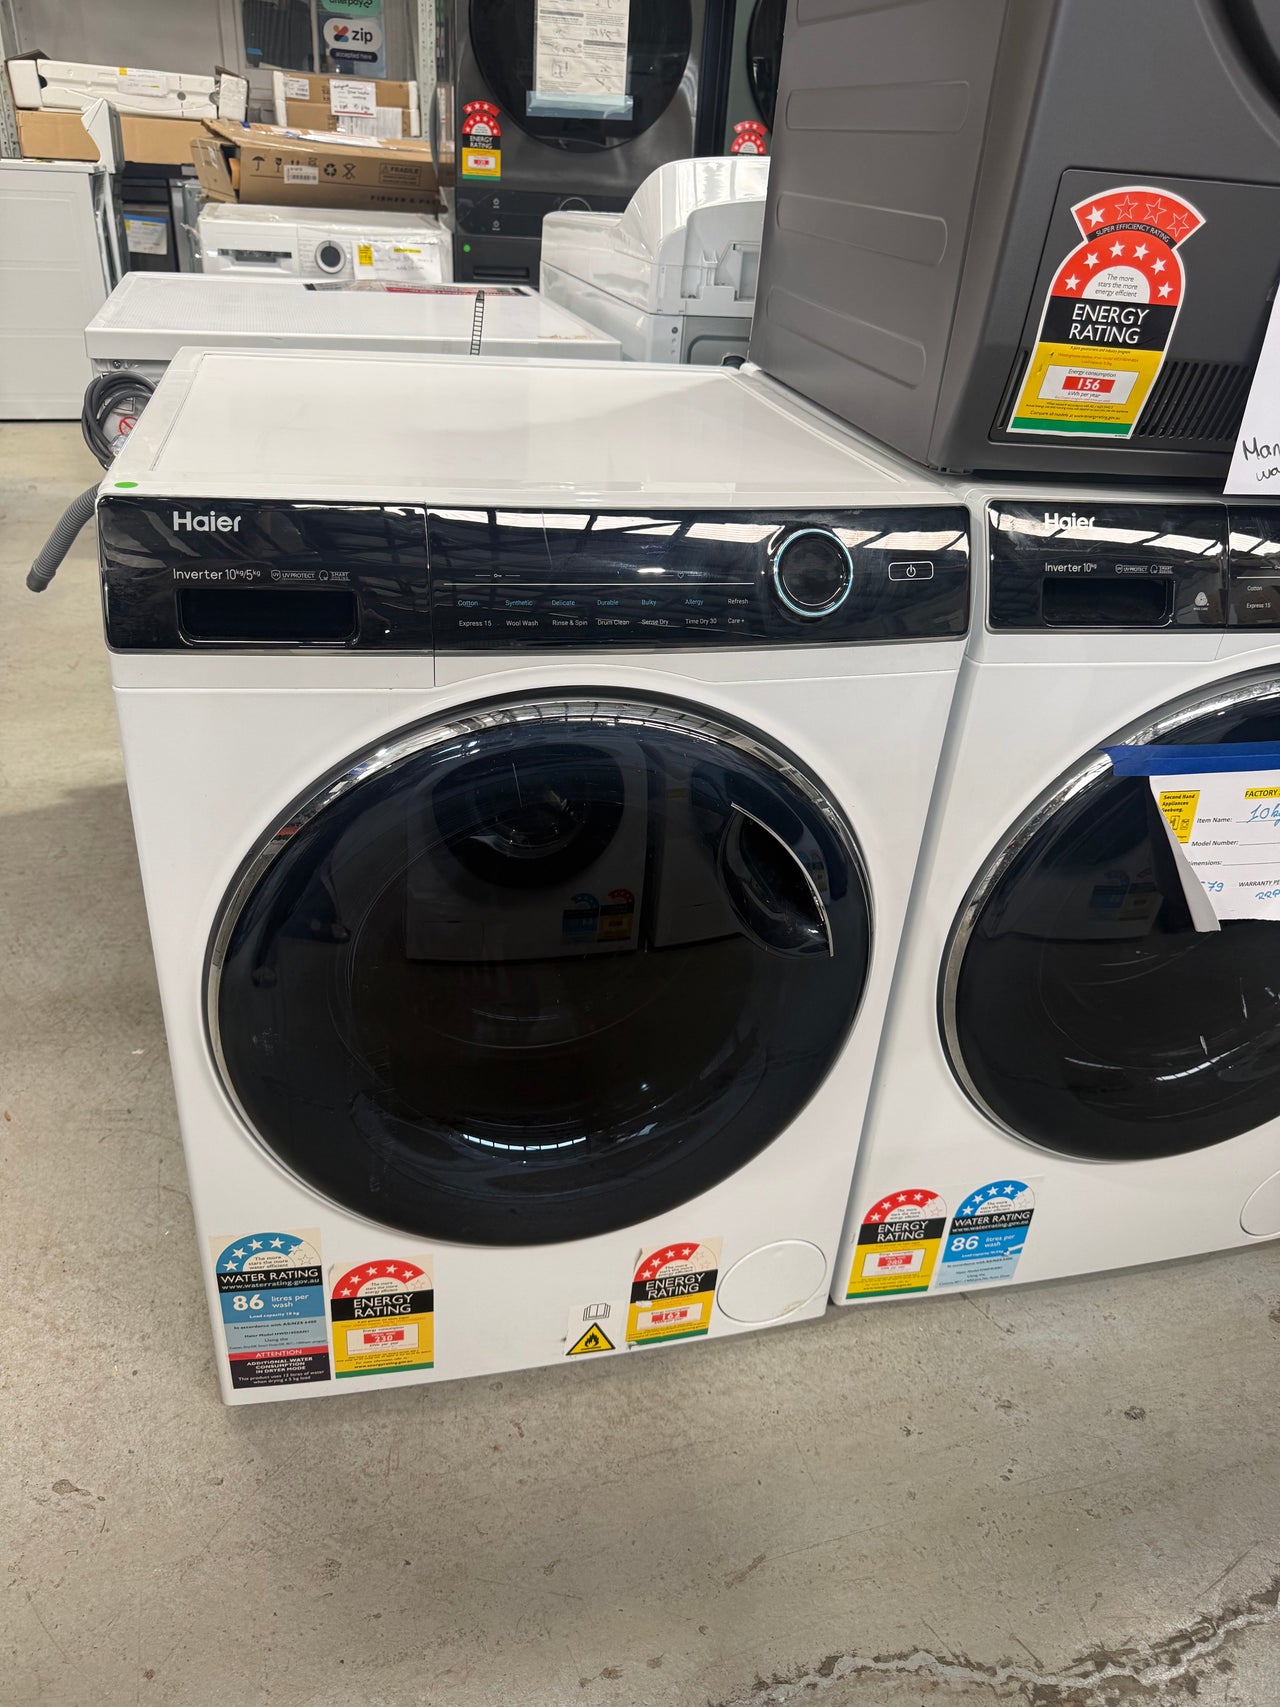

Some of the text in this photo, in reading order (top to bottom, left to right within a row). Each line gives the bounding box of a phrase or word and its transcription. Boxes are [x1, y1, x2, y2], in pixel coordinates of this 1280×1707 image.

[352, 28, 372, 44] zip
[1096, 224, 1170, 243] SUPER EFFICIENCY RATING
[1072, 304, 1150, 326] ENERGY
[1069, 323, 1141, 344] RATING
[1077, 378, 1100, 390] 156
[172, 510, 241, 532] Haier
[1044, 512, 1096, 529] Haier
[173, 568, 223, 580] Inverter
[1045, 563, 1097, 573] Inverter 10kg
[1245, 789, 1278, 798] FACTORY
[878, 1221, 928, 1233] ENERGY
[952, 1221, 1029, 1232] www.waterrating.gov.au
[954, 1212, 1031, 1227] WATER RATING
[877, 1231, 924, 1242] RATING
[951, 1236, 979, 1251] 86
[220, 1269, 318, 1284] WATER RATING
[222, 1278, 320, 1290] www.waterrating.gov.au
[646, 1273, 705, 1291] ENERGY
[648, 1283, 699, 1299] RATING
[233, 1294, 264, 1311] 86
[354, 1294, 413, 1308] ENERGY
[355, 1304, 411, 1318] RATING
[256, 1349, 302, 1358] ATTENTION
